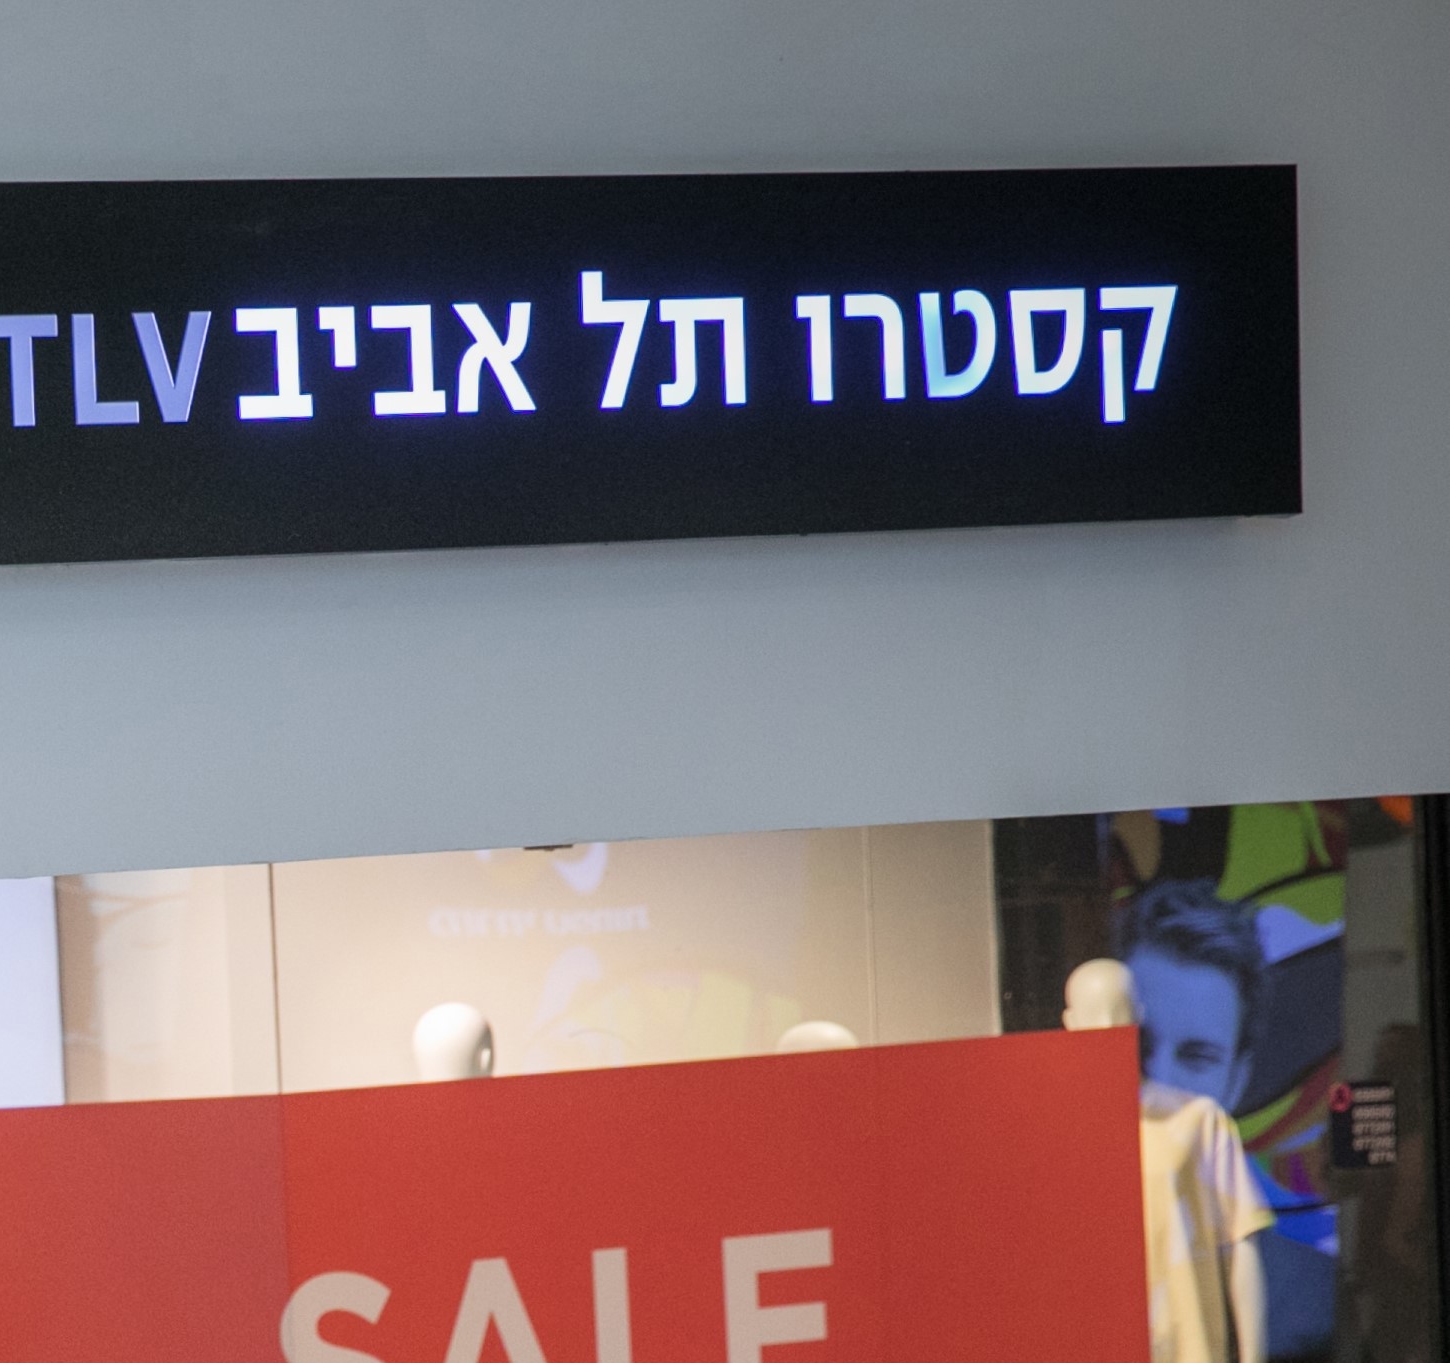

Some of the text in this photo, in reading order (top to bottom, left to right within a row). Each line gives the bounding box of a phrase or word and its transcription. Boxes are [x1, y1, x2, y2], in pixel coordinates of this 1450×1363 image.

[235, 301, 537, 420] אביב
[581, 270, 747, 408] תל
[796, 285, 1179, 423] קסטרו
